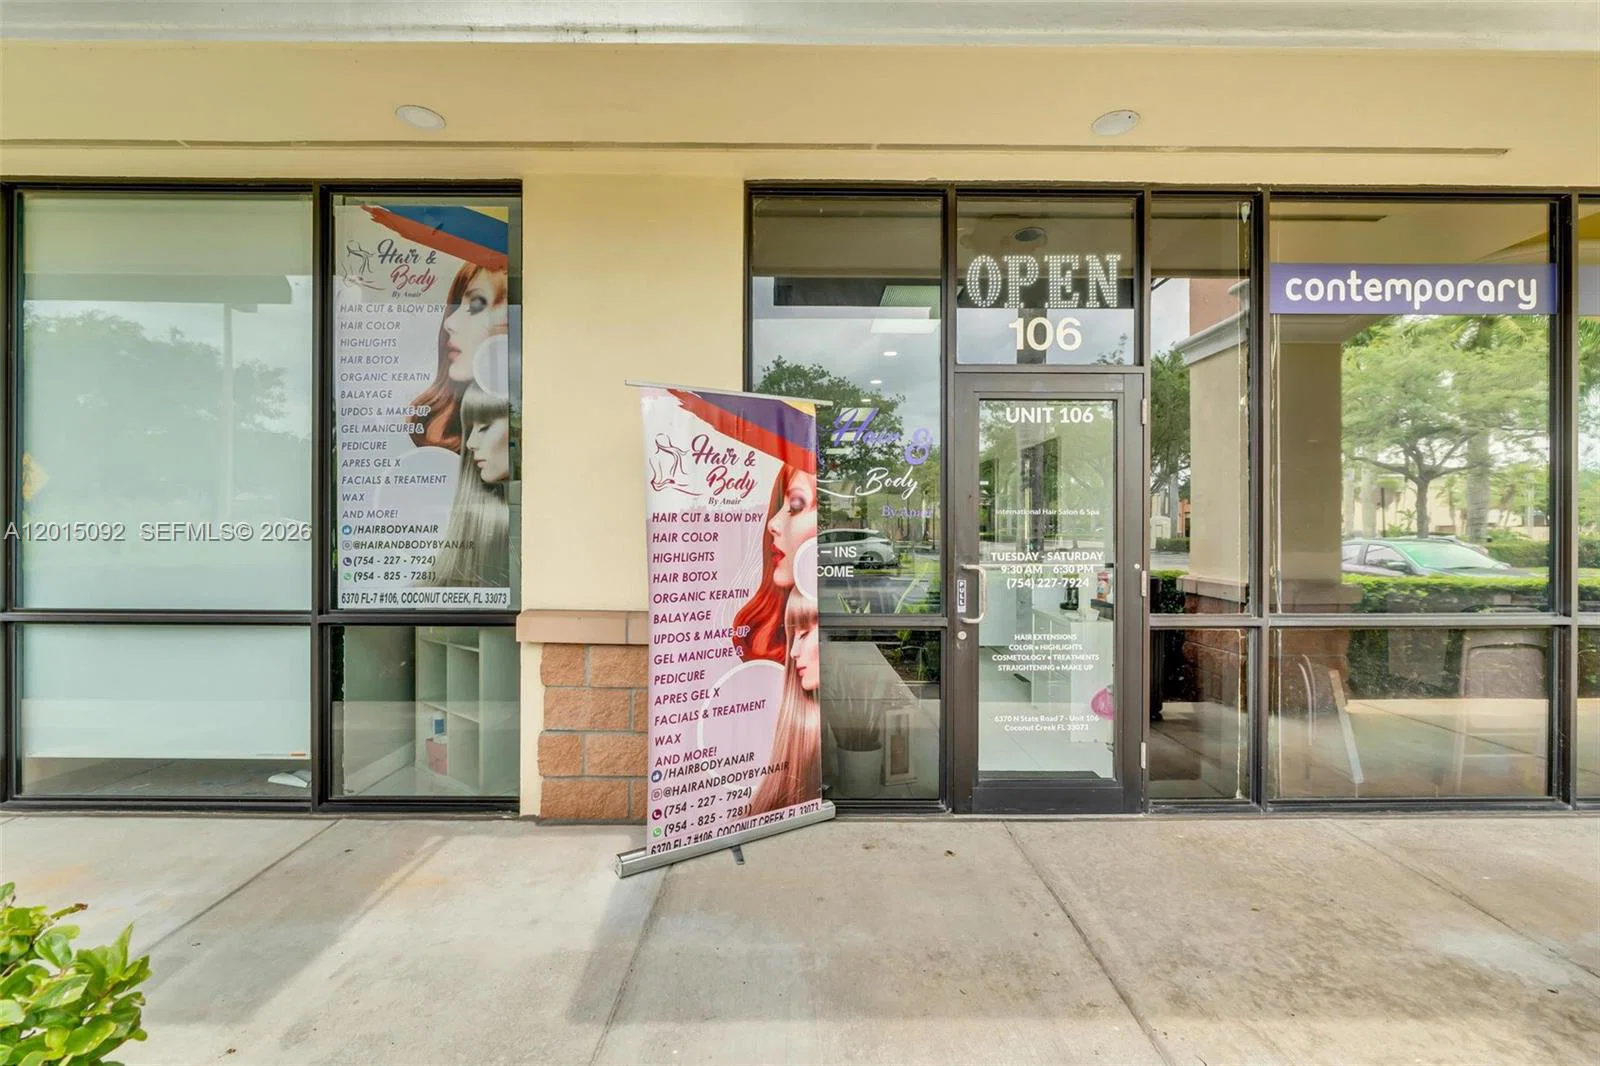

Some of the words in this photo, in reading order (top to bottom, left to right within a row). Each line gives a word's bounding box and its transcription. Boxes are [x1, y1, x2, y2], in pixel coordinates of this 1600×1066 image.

[377, 238, 420, 265] Hair
[425, 250, 437, 265] &
[390, 264, 438, 292] Body
[966, 254, 1122, 309] OPEN
[391, 291, 401, 299] By
[1285, 270, 1537, 310] contemporary
[340, 304, 363, 313] HAIR
[365, 304, 385, 313] CUT
[387, 304, 393, 313] &
[396, 304, 425, 313] BLOW
[427, 304, 445, 313] DRY
[340, 321, 363, 330] HAIR
[366, 321, 400, 330] COLOR
[1008, 316, 1082, 351] 106
[340, 338, 397, 347] HIGHLIGHTS
[340, 355, 363, 364] HAIR
[365, 355, 399, 364] BOTOX
[340, 372, 388, 382] ORGANIC
[391, 372, 430, 381] KERATIN
[340, 389, 393, 399] BALAYAGE
[340, 407, 374, 416] UPDOS
[376, 407, 383, 415] &
[386, 406, 431, 415] MAKE-UP
[1005, 407, 1054, 423] UNIT
[1059, 407, 1094, 423] 106
[341, 424, 360, 433] GEL
[361, 424, 414, 433] MANICURE
[415, 423, 425, 433] &
[341, 441, 387, 451] PEDICURE
[691, 434, 740, 466] Hair
[744, 450, 756, 467] &
[341, 459, 371, 468] APRES
[373, 458, 392, 467] GEL
[394, 458, 401, 467] X
[341, 476, 382, 485] FACIALS
[384, 476, 391, 484] &
[393, 475, 447, 484] TREATMENT
[706, 465, 758, 499] Body
[855, 465, 918, 500] Body
[342, 493, 365, 502] WAX
[708, 497, 718, 506] By
[720, 497, 742, 505] Anair
[342, 510, 364, 519] AND
[366, 510, 399, 518] MORE!
[652, 513, 677, 523] HAIR
[681, 513, 701, 522] CUT
[703, 513, 710, 522] &
[714, 513, 742, 522] BLOW
[744, 512, 764, 522] DRY
[1086, 508, 1099, 516] Spa
[352, 524, 439, 535] /HAIRBODYANAIR
[652, 533, 678, 543] HAIR
[681, 532, 719, 543] COLOR
[353, 540, 475, 550] @HAIRANDBODYBYANAIR
[353, 556, 374, 567] (754
[383, 556, 401, 565] 227
[410, 556, 436, 566] 7924)
[652, 551, 715, 564] HIGHLIGHTS
[991, 552, 1039, 561] TUESDAY
[1047, 552, 1105, 561] SATURDAY
[1001, 565, 1023, 574] 9:30
[1024, 565, 1043, 574] AM
[1053, 565, 1075, 574] 6:30
[1077, 565, 1094, 574] PM
[353, 572, 374, 582] (954
[383, 572, 401, 581] 825
[410, 572, 436, 582] 7281)
[652, 572, 680, 584] HAIR
[682, 571, 718, 582] BOTOX
[1006, 578, 1035, 590] (754)
[1037, 578, 1089, 588] 227-7924
[341, 593, 359, 604] 6370
[360, 592, 377, 604] FL-7
[379, 592, 399, 605] #106,
[401, 592, 441, 604] COCONUT
[442, 592, 471, 605] CREEK,
[473, 592, 483, 604] FL
[485, 592, 507, 604] 33073
[653, 590, 706, 605] ORGANIC
[709, 588, 750, 601] KERATIN
[653, 610, 712, 625] BALAYAGE
[653, 632, 691, 645] UPDOS
[693, 631, 701, 641] &
[703, 626, 750, 640] MAKE-UP
[653, 653, 674, 665] GEL
[678, 648, 734, 663] MANICURE
[735, 647, 743, 657] &
[654, 670, 705, 686] PEDICURE
[654, 692, 688, 706] APRES
[690, 689, 711, 702] GEL
[712, 687, 721, 698] X
[654, 710, 699, 727] FACIALS
[702, 709, 710, 719] &
[712, 700, 766, 718] TREATMENT
[1004, 724, 1034, 732] Coconut
[654, 734, 682, 747] WAX
[655, 754, 680, 767] AND
[683, 747, 717, 761] MORE!
[663, 752, 755, 780] /HAIRBODYANAIR
[663, 761, 790, 798] @HAIRANDBODYBYANAIR
[664, 804, 687, 818] (754
[697, 796, 715, 809] 227
[726, 787, 752, 801] 7924)
[664, 821, 687, 837] (954
[697, 813, 716, 826] 825
[726, 804, 752, 819] 7281)
[717, 818, 757, 837] COCONUT
